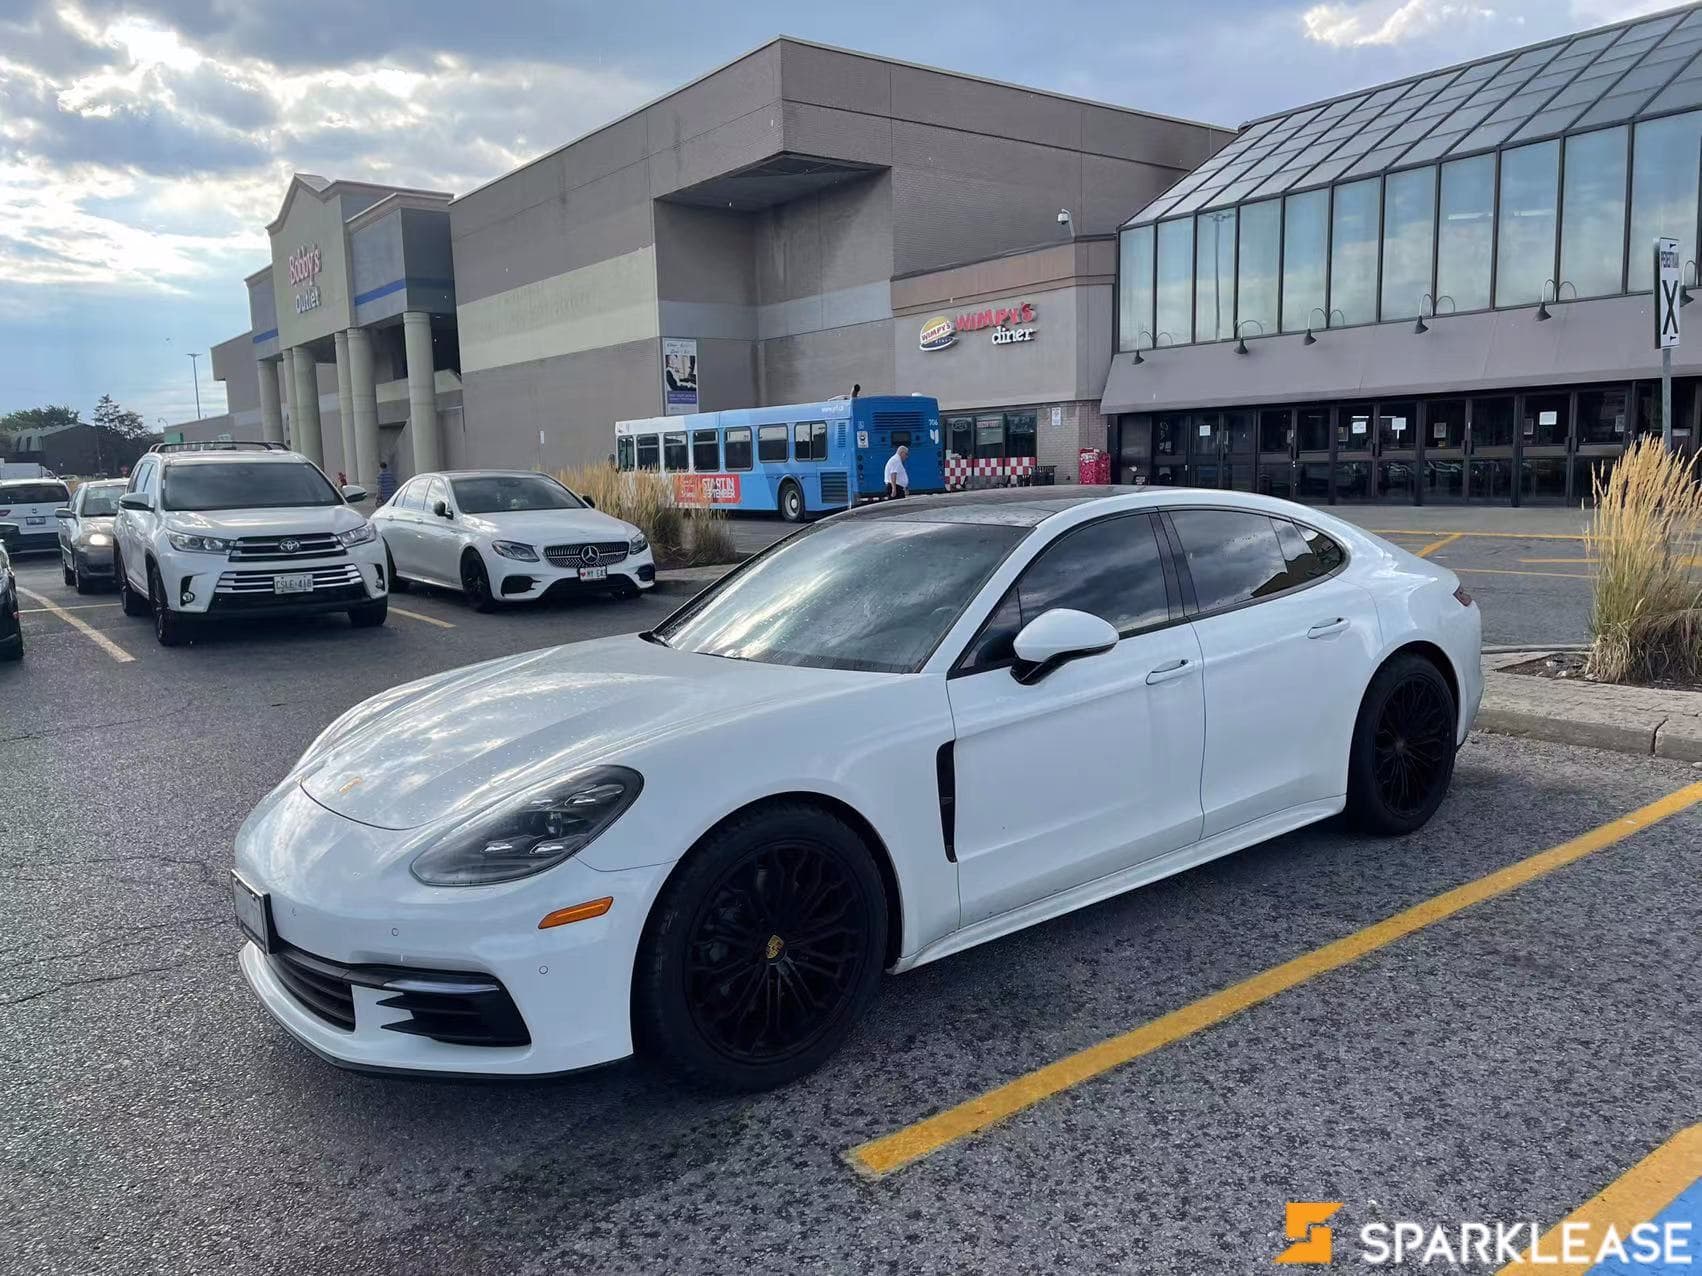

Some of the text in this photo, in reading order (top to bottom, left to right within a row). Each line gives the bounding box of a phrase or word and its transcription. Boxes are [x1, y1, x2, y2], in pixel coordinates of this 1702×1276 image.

[289, 247, 321, 286] Bobby's
[295, 287, 320, 314] Outlet
[1662, 280, 1678, 334] X
[955, 303, 1034, 332] WIMPY'S
[991, 326, 1033, 344] diner
